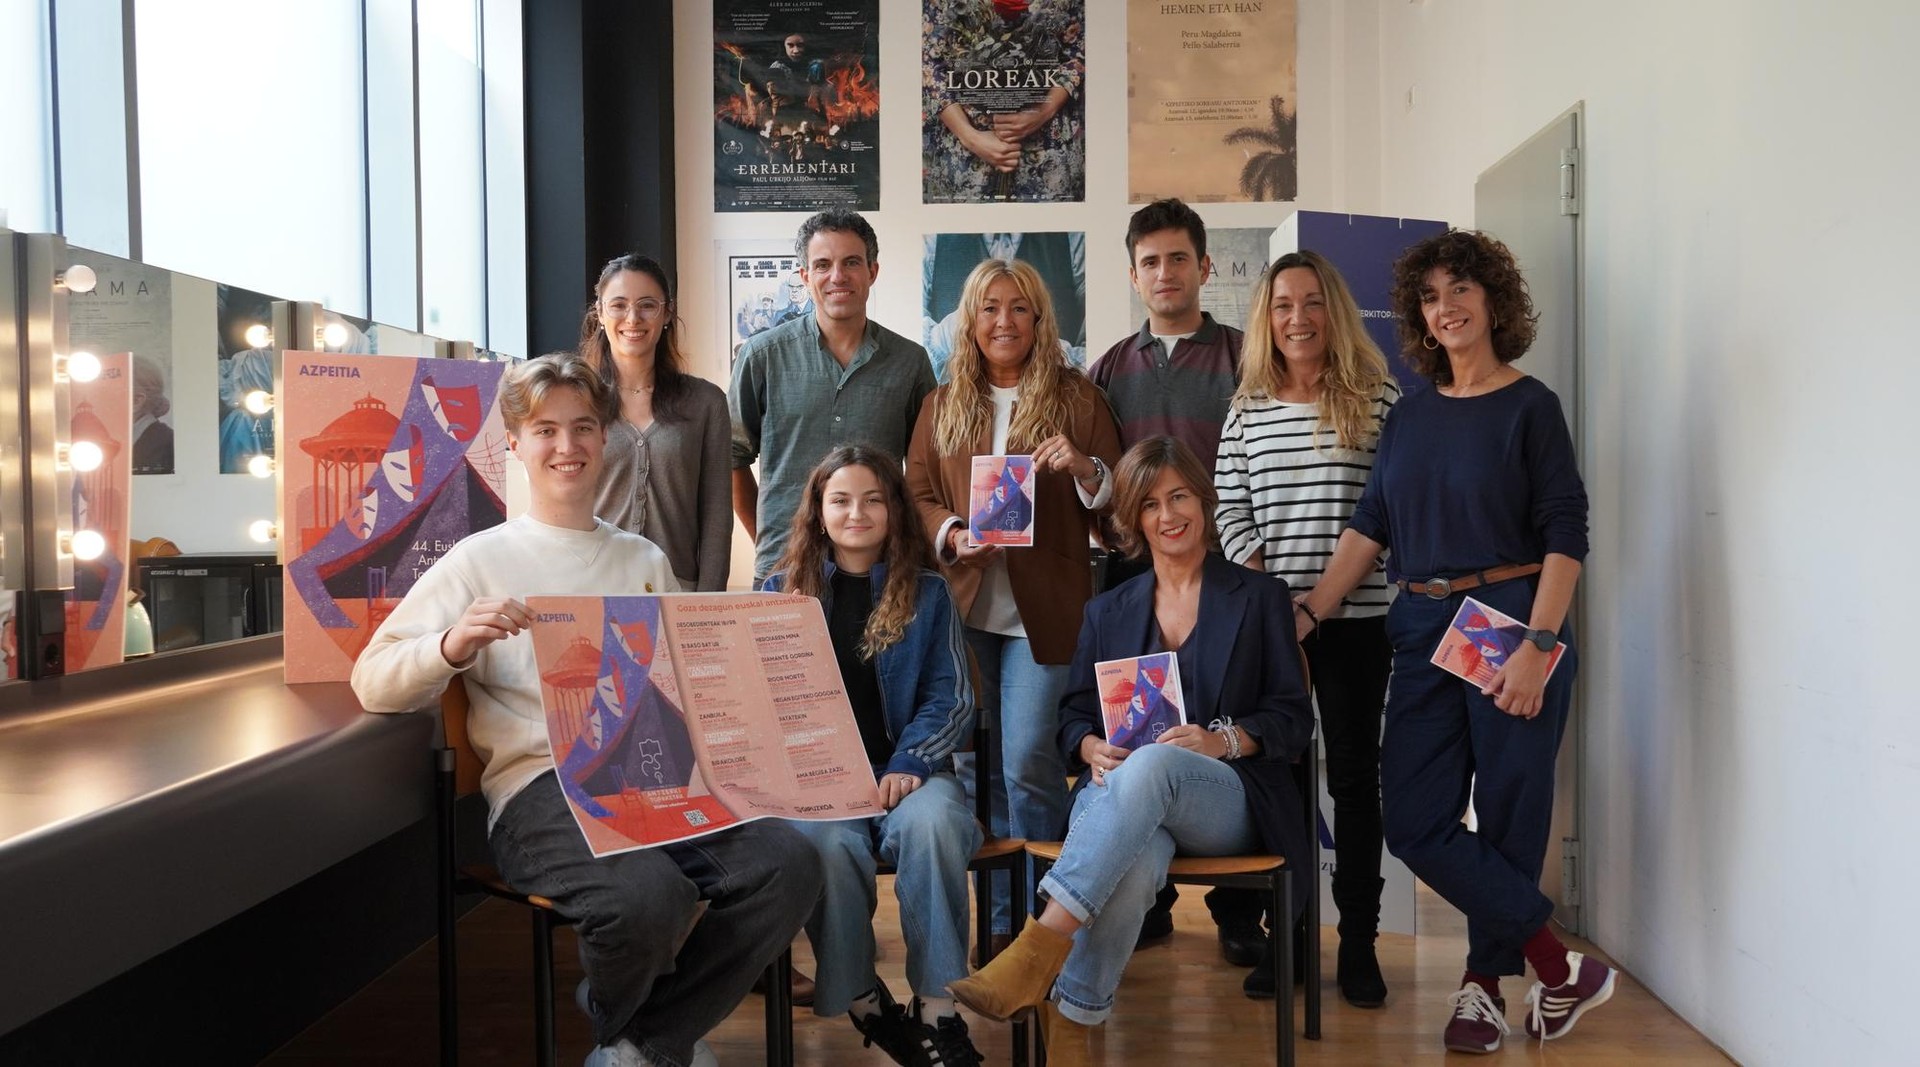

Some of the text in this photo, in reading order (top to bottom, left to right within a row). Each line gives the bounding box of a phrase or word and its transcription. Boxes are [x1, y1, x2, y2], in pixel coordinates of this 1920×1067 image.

[1160, 2, 1262, 14] HEMEN ETA HAN
[1181, 30, 1241, 39] Peru Magdalena
[1182, 40, 1240, 49] Pello Salaberria
[947, 69, 1061, 89] LOREAK
[734, 159, 856, 175] ERREMENTARI
[299, 364, 361, 378] AZPEITIA
[411, 540, 431, 552] 44.
[418, 554, 440, 566] Ant
[677, 604, 697, 612] Goza
[698, 603, 734, 613] dezagun
[735, 600, 764, 610] euskal
[536, 612, 576, 624] AZPEITIA
[761, 654, 790, 663] DIAMANTE
